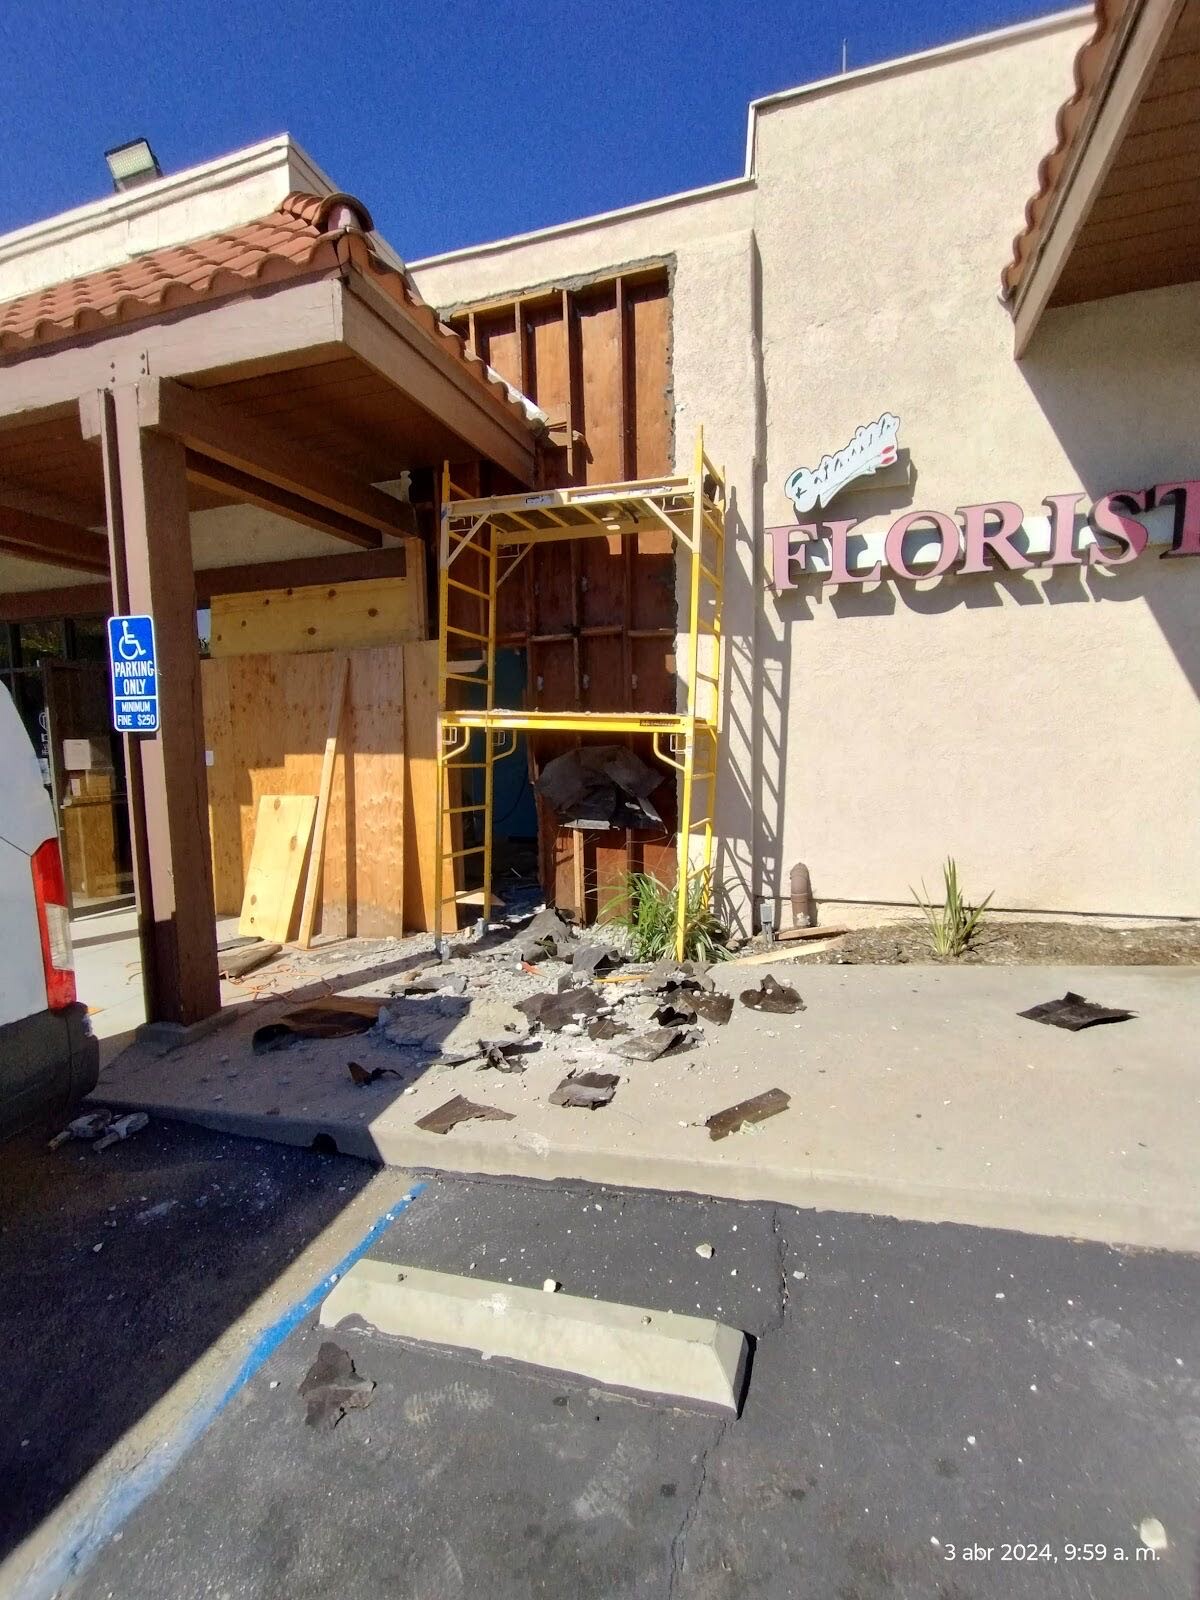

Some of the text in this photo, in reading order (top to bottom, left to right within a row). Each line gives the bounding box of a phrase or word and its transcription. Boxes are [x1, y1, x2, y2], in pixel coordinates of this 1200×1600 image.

[764, 480, 1200, 590] FLORIST
[115, 660, 154, 678] PARKING
[123, 678, 146, 695] ONLY
[121, 701, 151, 712] MINIMUM
[117, 714, 155, 726] FINE $250
